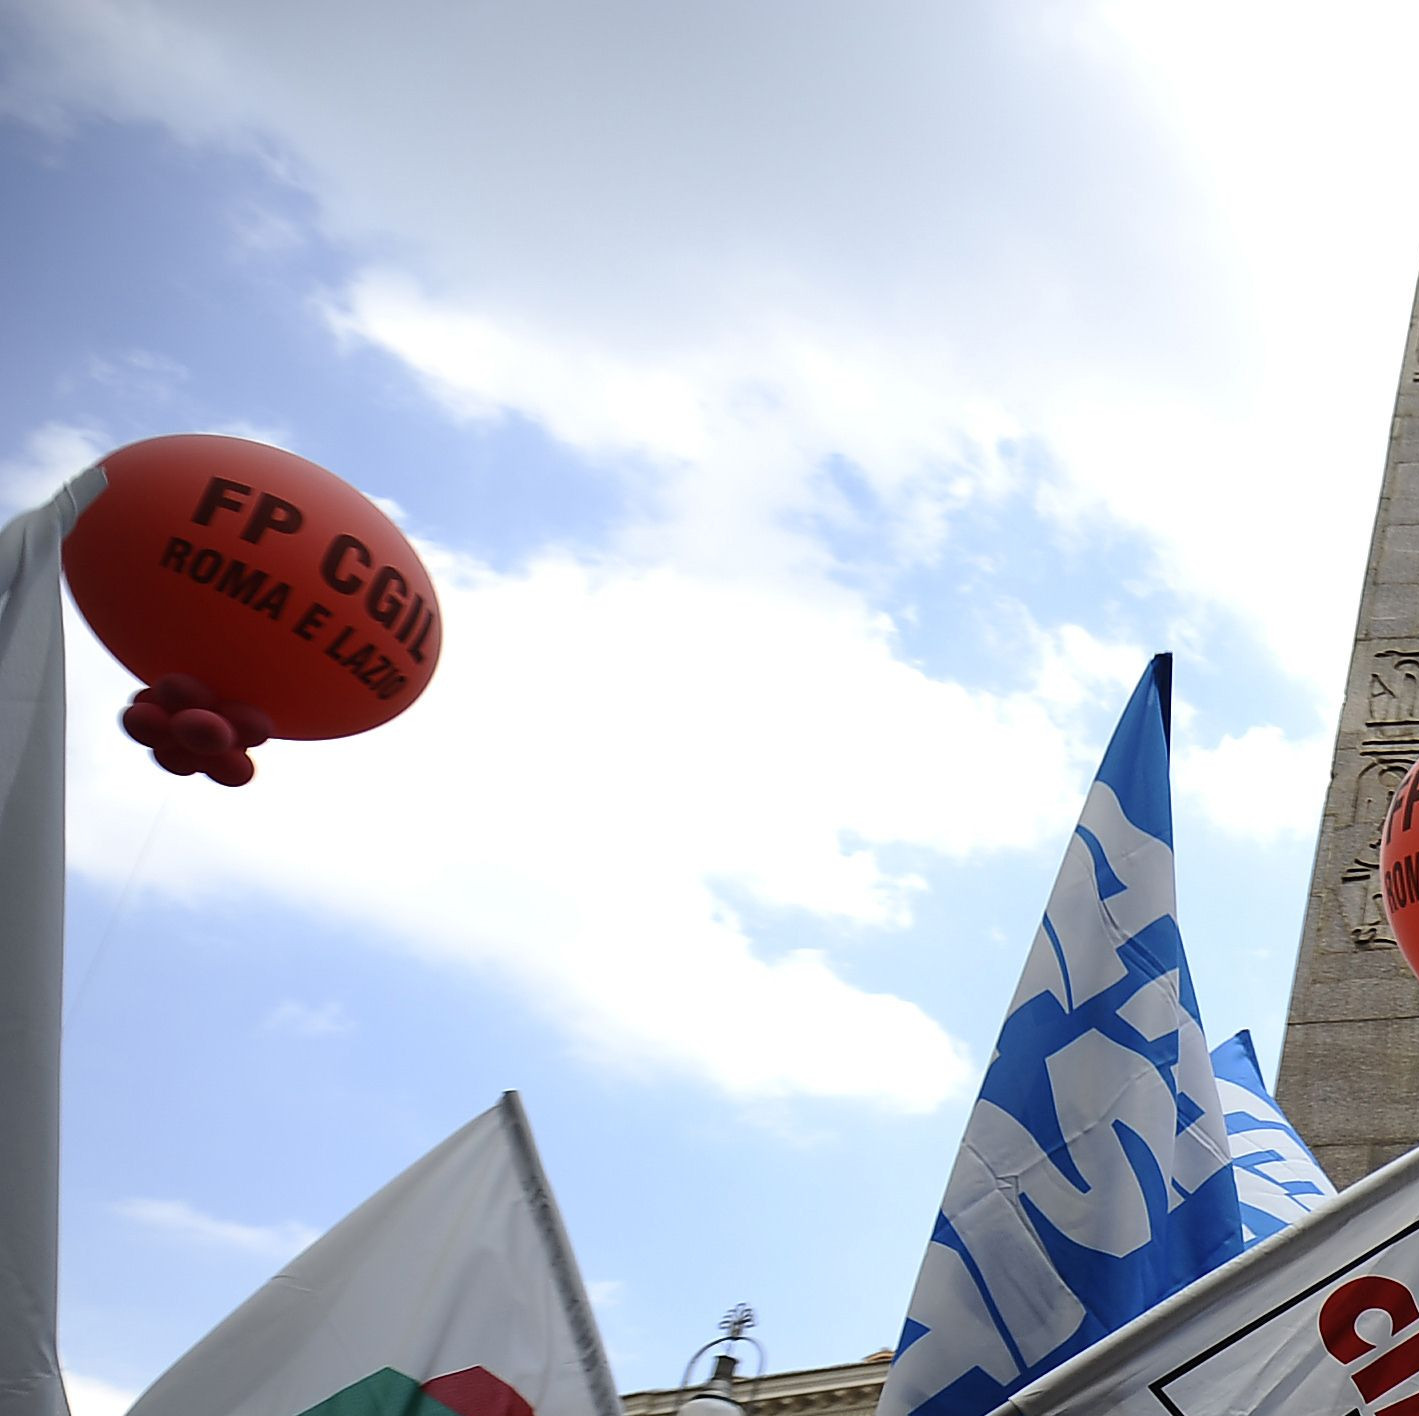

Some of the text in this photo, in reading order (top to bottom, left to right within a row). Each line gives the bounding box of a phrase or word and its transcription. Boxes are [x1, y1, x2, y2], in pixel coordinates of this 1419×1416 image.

[159, 536, 411, 701] ROMA E LAZIO
[191, 474, 437, 665] FP CGIL
